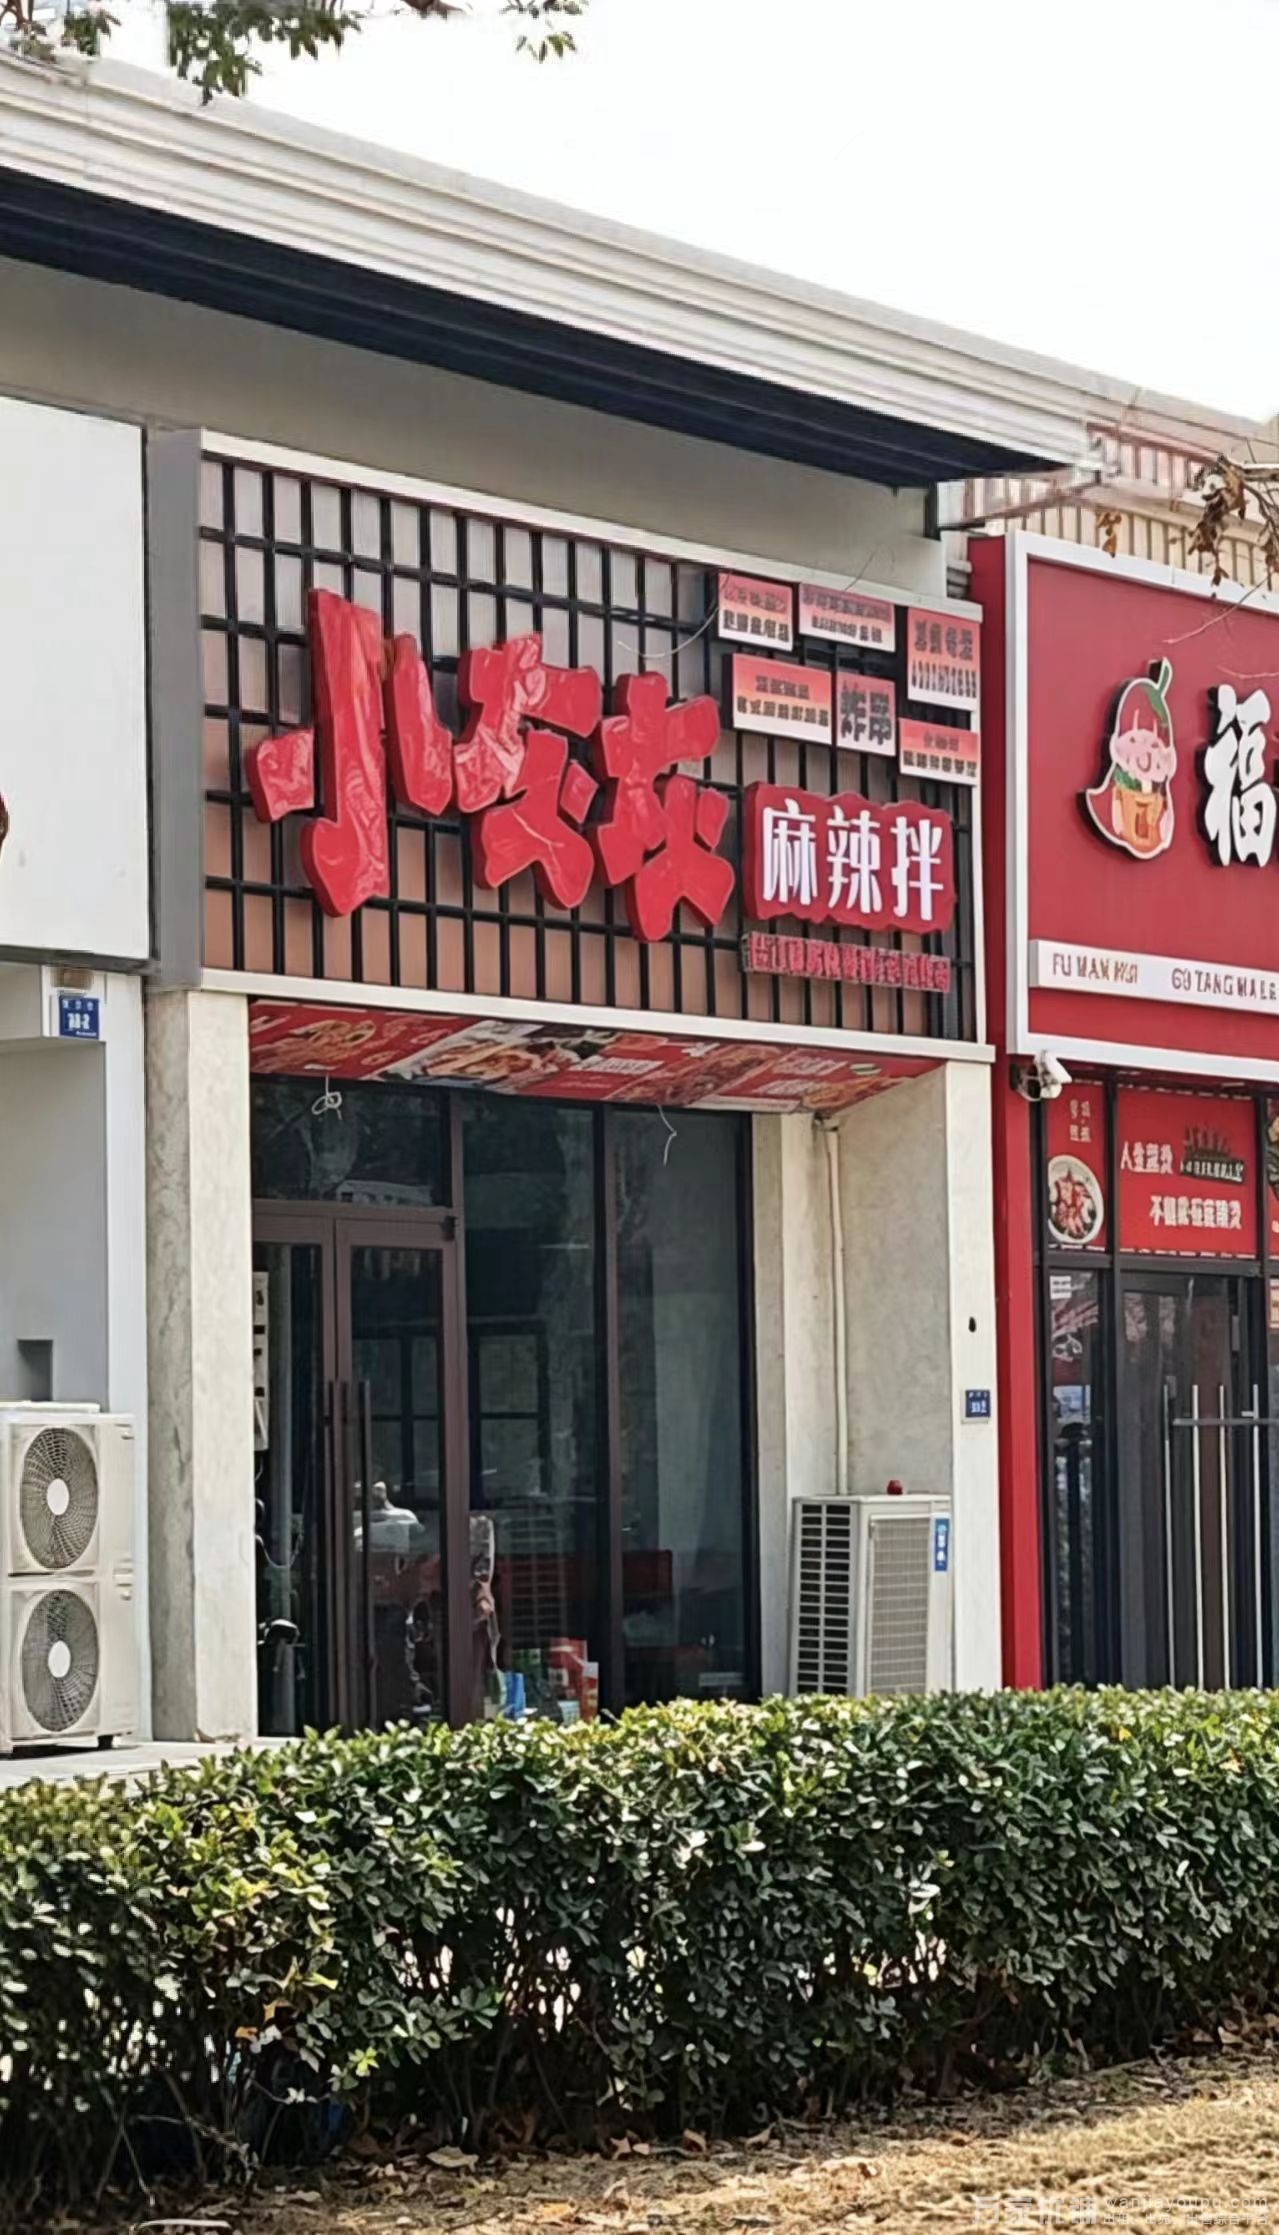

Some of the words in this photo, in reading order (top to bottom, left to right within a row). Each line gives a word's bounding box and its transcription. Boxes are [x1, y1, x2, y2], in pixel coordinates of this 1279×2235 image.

[1204, 684, 1276, 867] 福
[762, 798, 944, 921] 麻辣拌
